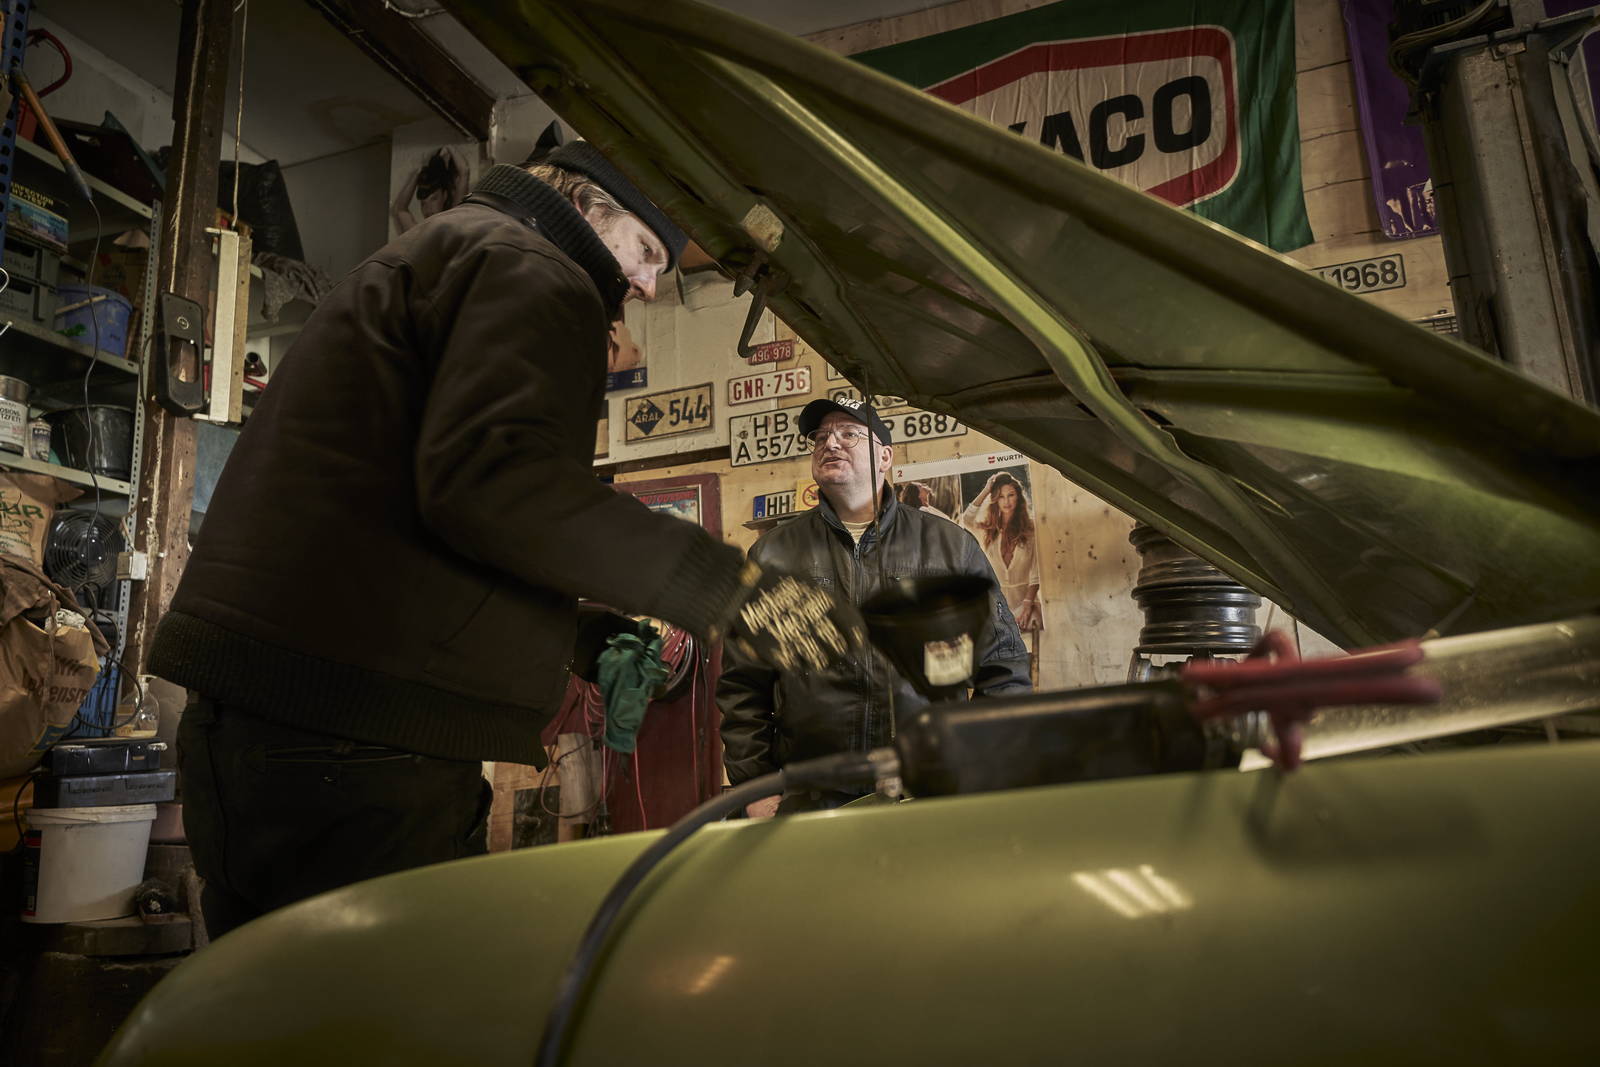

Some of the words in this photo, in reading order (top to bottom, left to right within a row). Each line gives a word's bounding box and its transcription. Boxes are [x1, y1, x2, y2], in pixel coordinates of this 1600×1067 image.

[1008, 76, 1211, 169] ACO
[1331, 260, 1399, 290] 1968
[634, 412, 660, 424] ARAL
[669, 394, 709, 427] 544
[753, 412, 789, 438] HB
[766, 495, 790, 517] HH
